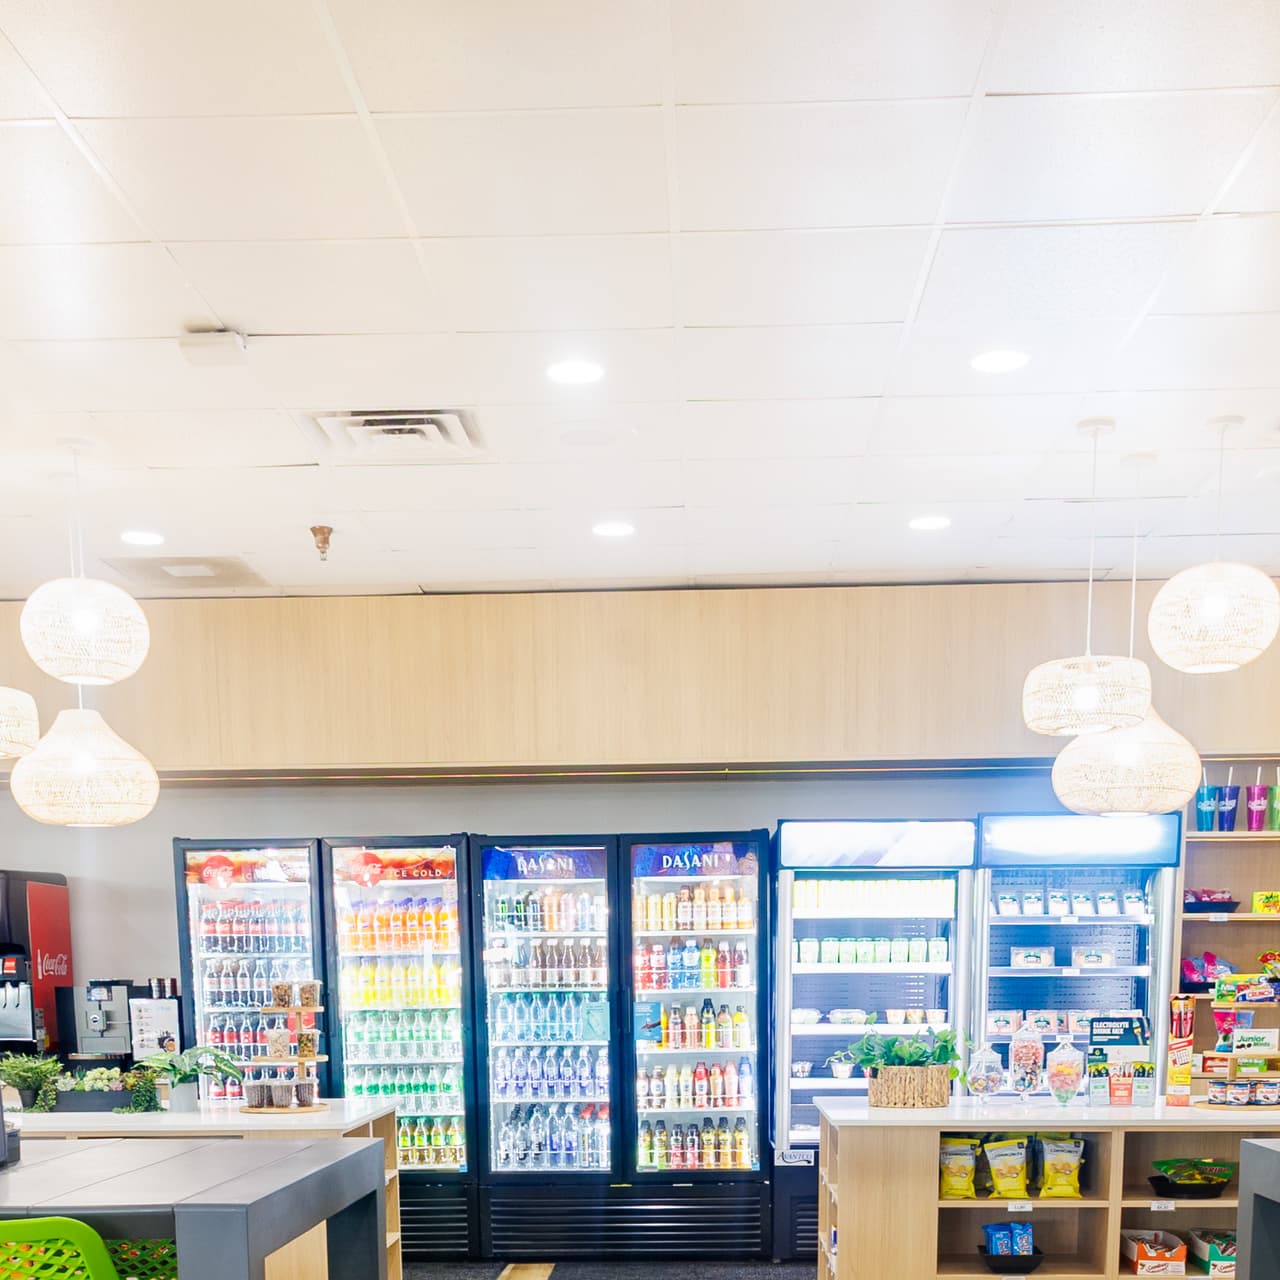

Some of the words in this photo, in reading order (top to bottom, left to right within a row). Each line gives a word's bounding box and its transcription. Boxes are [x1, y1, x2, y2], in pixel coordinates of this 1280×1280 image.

[663, 851, 718, 870] DASANI
[412, 869, 442, 878] COLD
[1237, 1035, 1266, 1043] Junior
